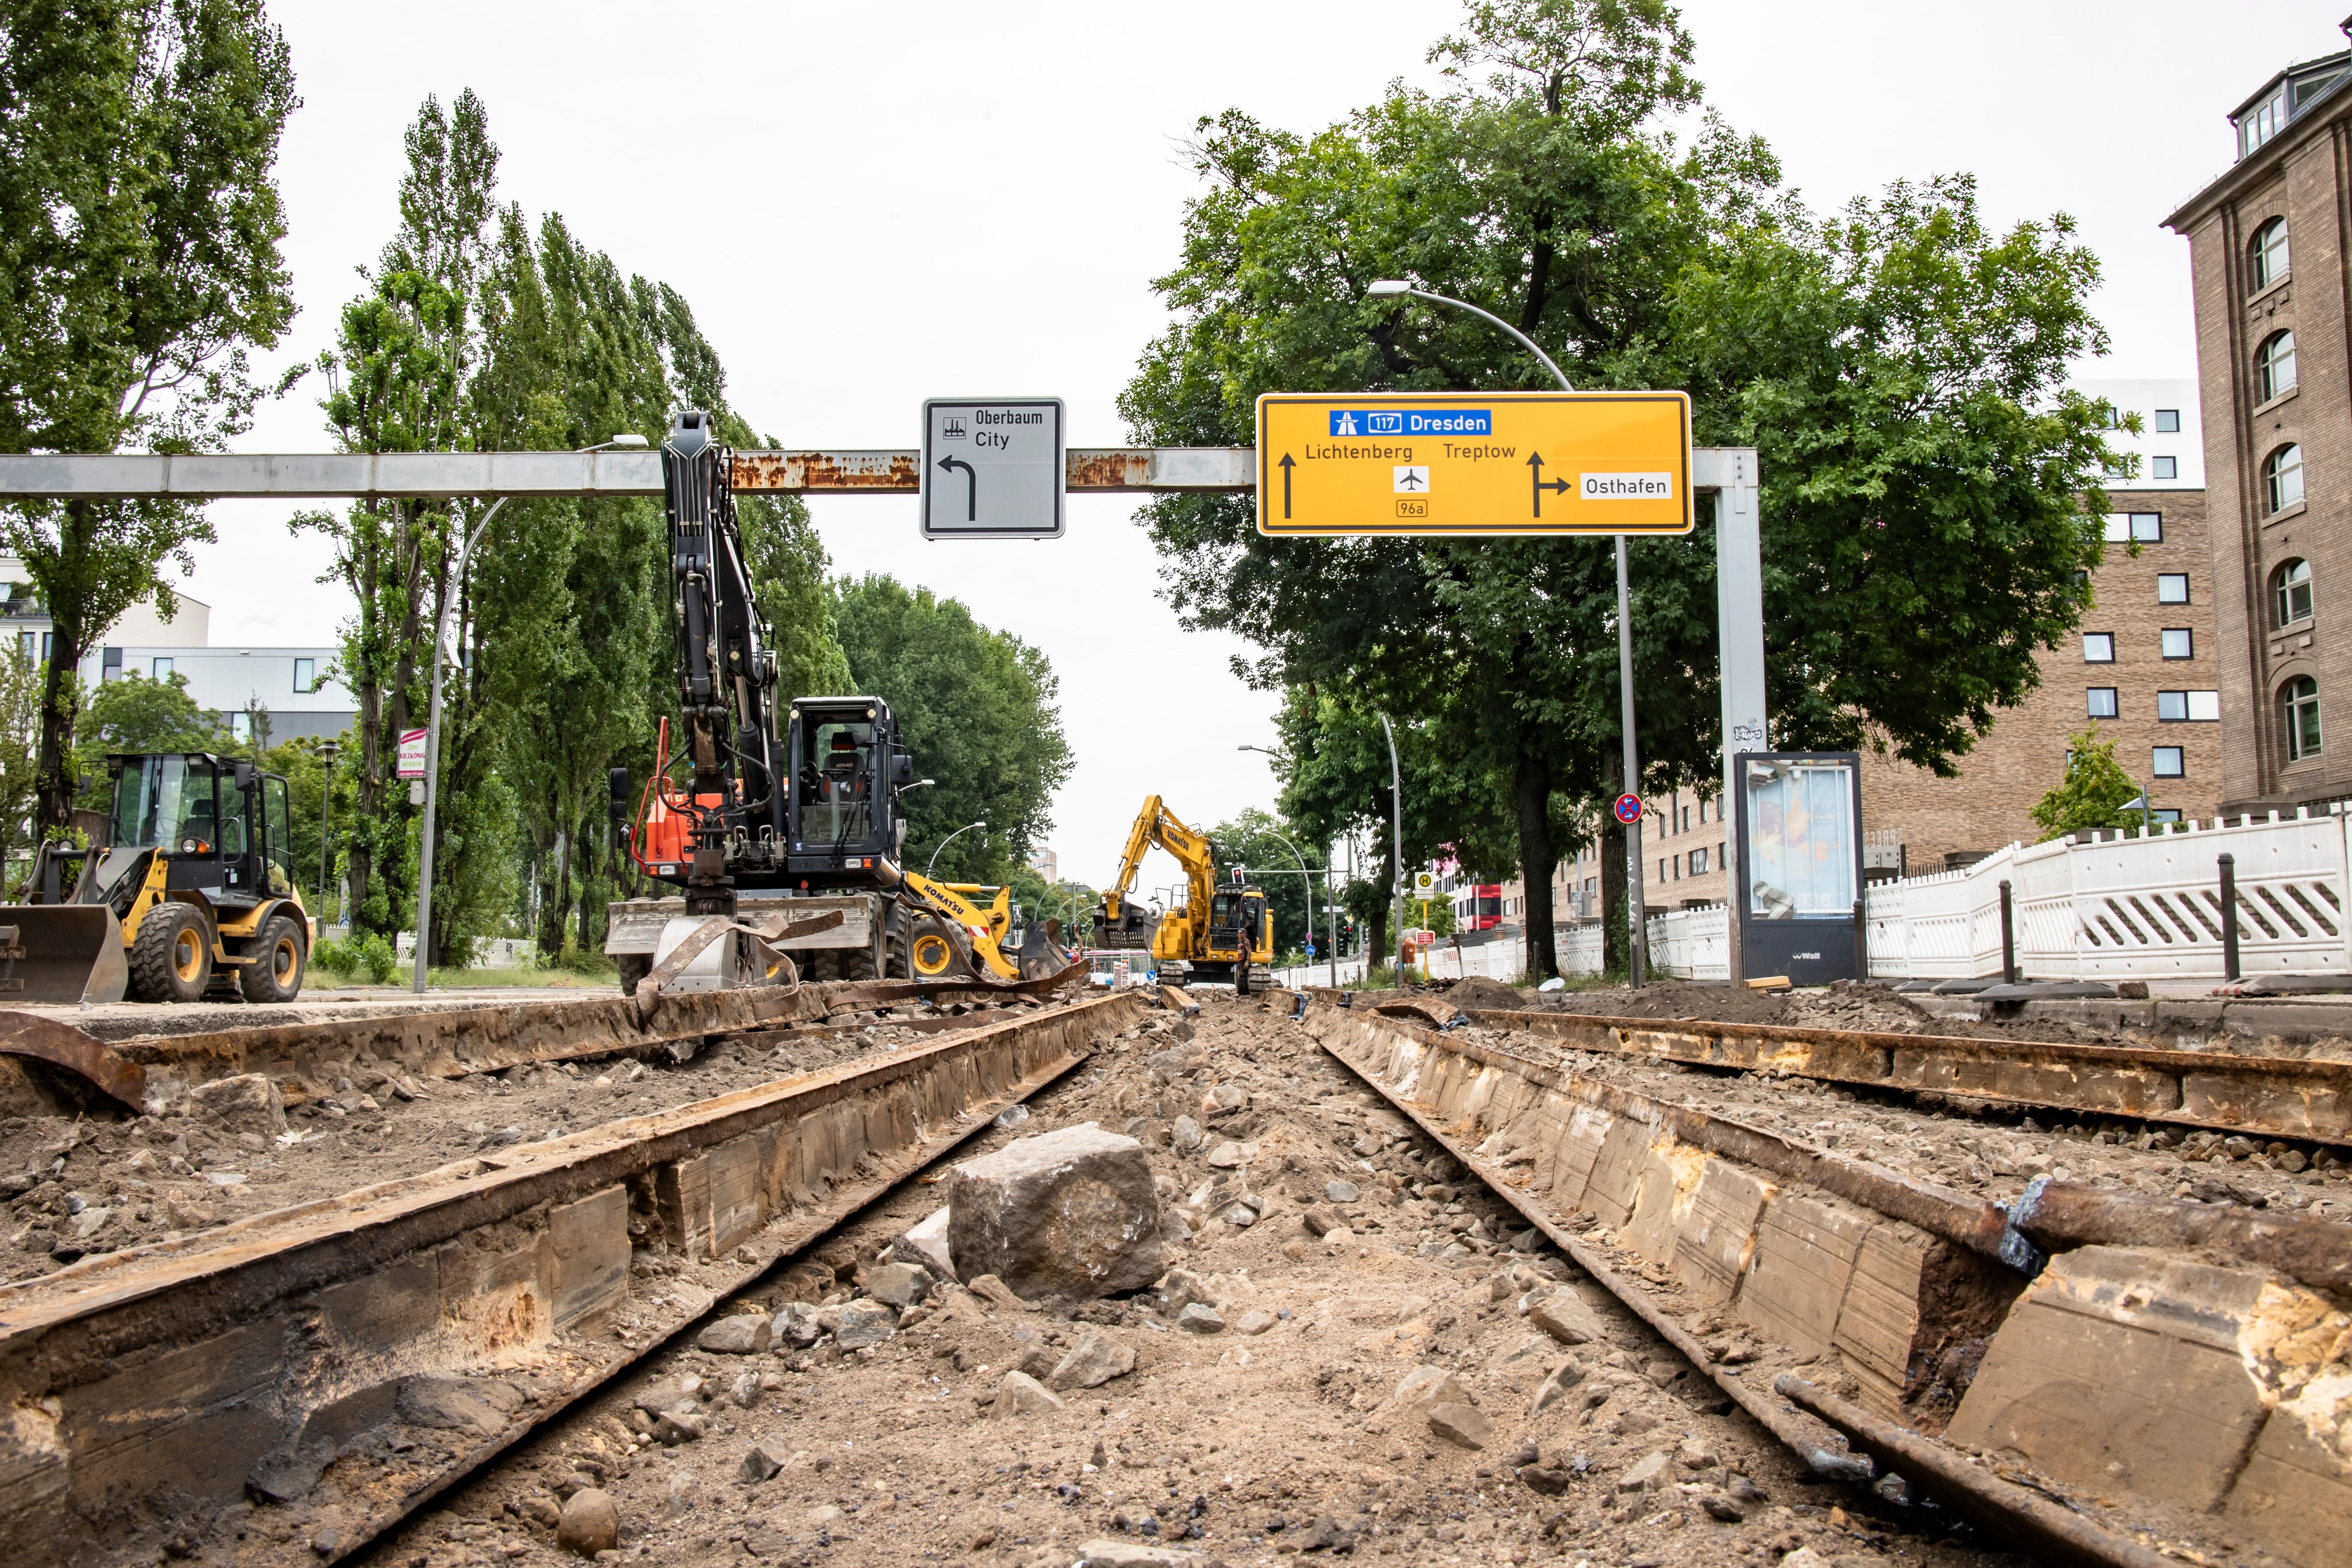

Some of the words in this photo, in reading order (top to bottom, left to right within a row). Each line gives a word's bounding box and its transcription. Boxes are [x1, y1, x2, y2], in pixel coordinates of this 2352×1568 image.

[976, 410, 1043, 424] Oberbaum
[1375, 417, 1394, 430] 117
[1411, 415, 1486, 431] Dresden
[976, 432, 1010, 450] City
[1306, 444, 1413, 462] Lichtenberg
[1443, 444, 1516, 461] Treptow
[1587, 479, 1666, 493] Osthafen
[1401, 503, 1423, 514] 96a
[1167, 829, 1189, 851] KOMATSU
[924, 884, 964, 914] KOMATSU
